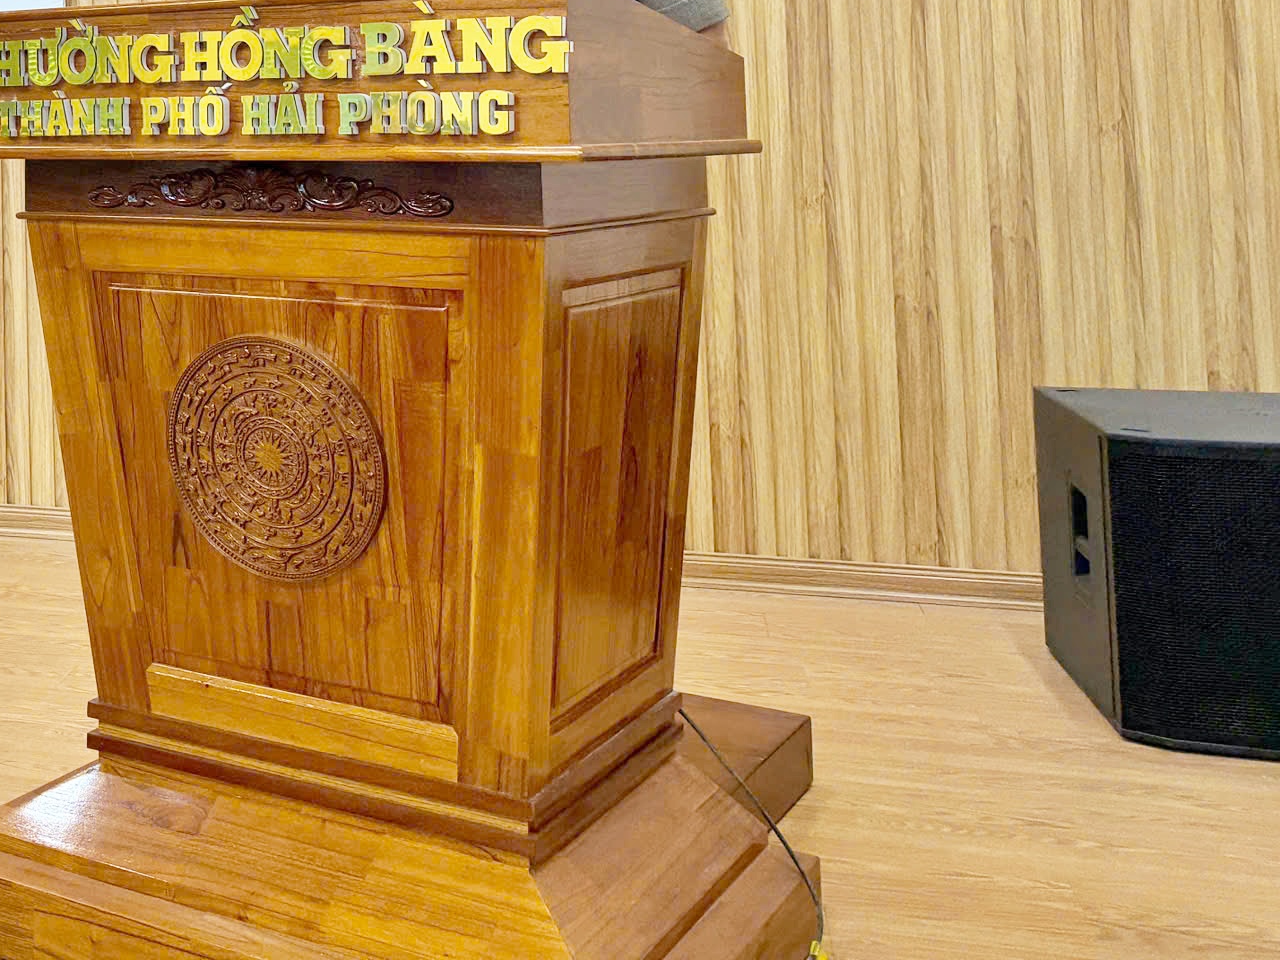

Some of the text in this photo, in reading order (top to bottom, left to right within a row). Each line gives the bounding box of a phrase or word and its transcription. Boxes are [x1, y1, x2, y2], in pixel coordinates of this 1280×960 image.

[180, 6, 355, 81] HỒNG
[360, 0, 572, 76] BÀNG
[141, 83, 231, 136] PHỐ
[241, 81, 324, 135] HẢI
[338, 79, 514, 136] PHÒNG
